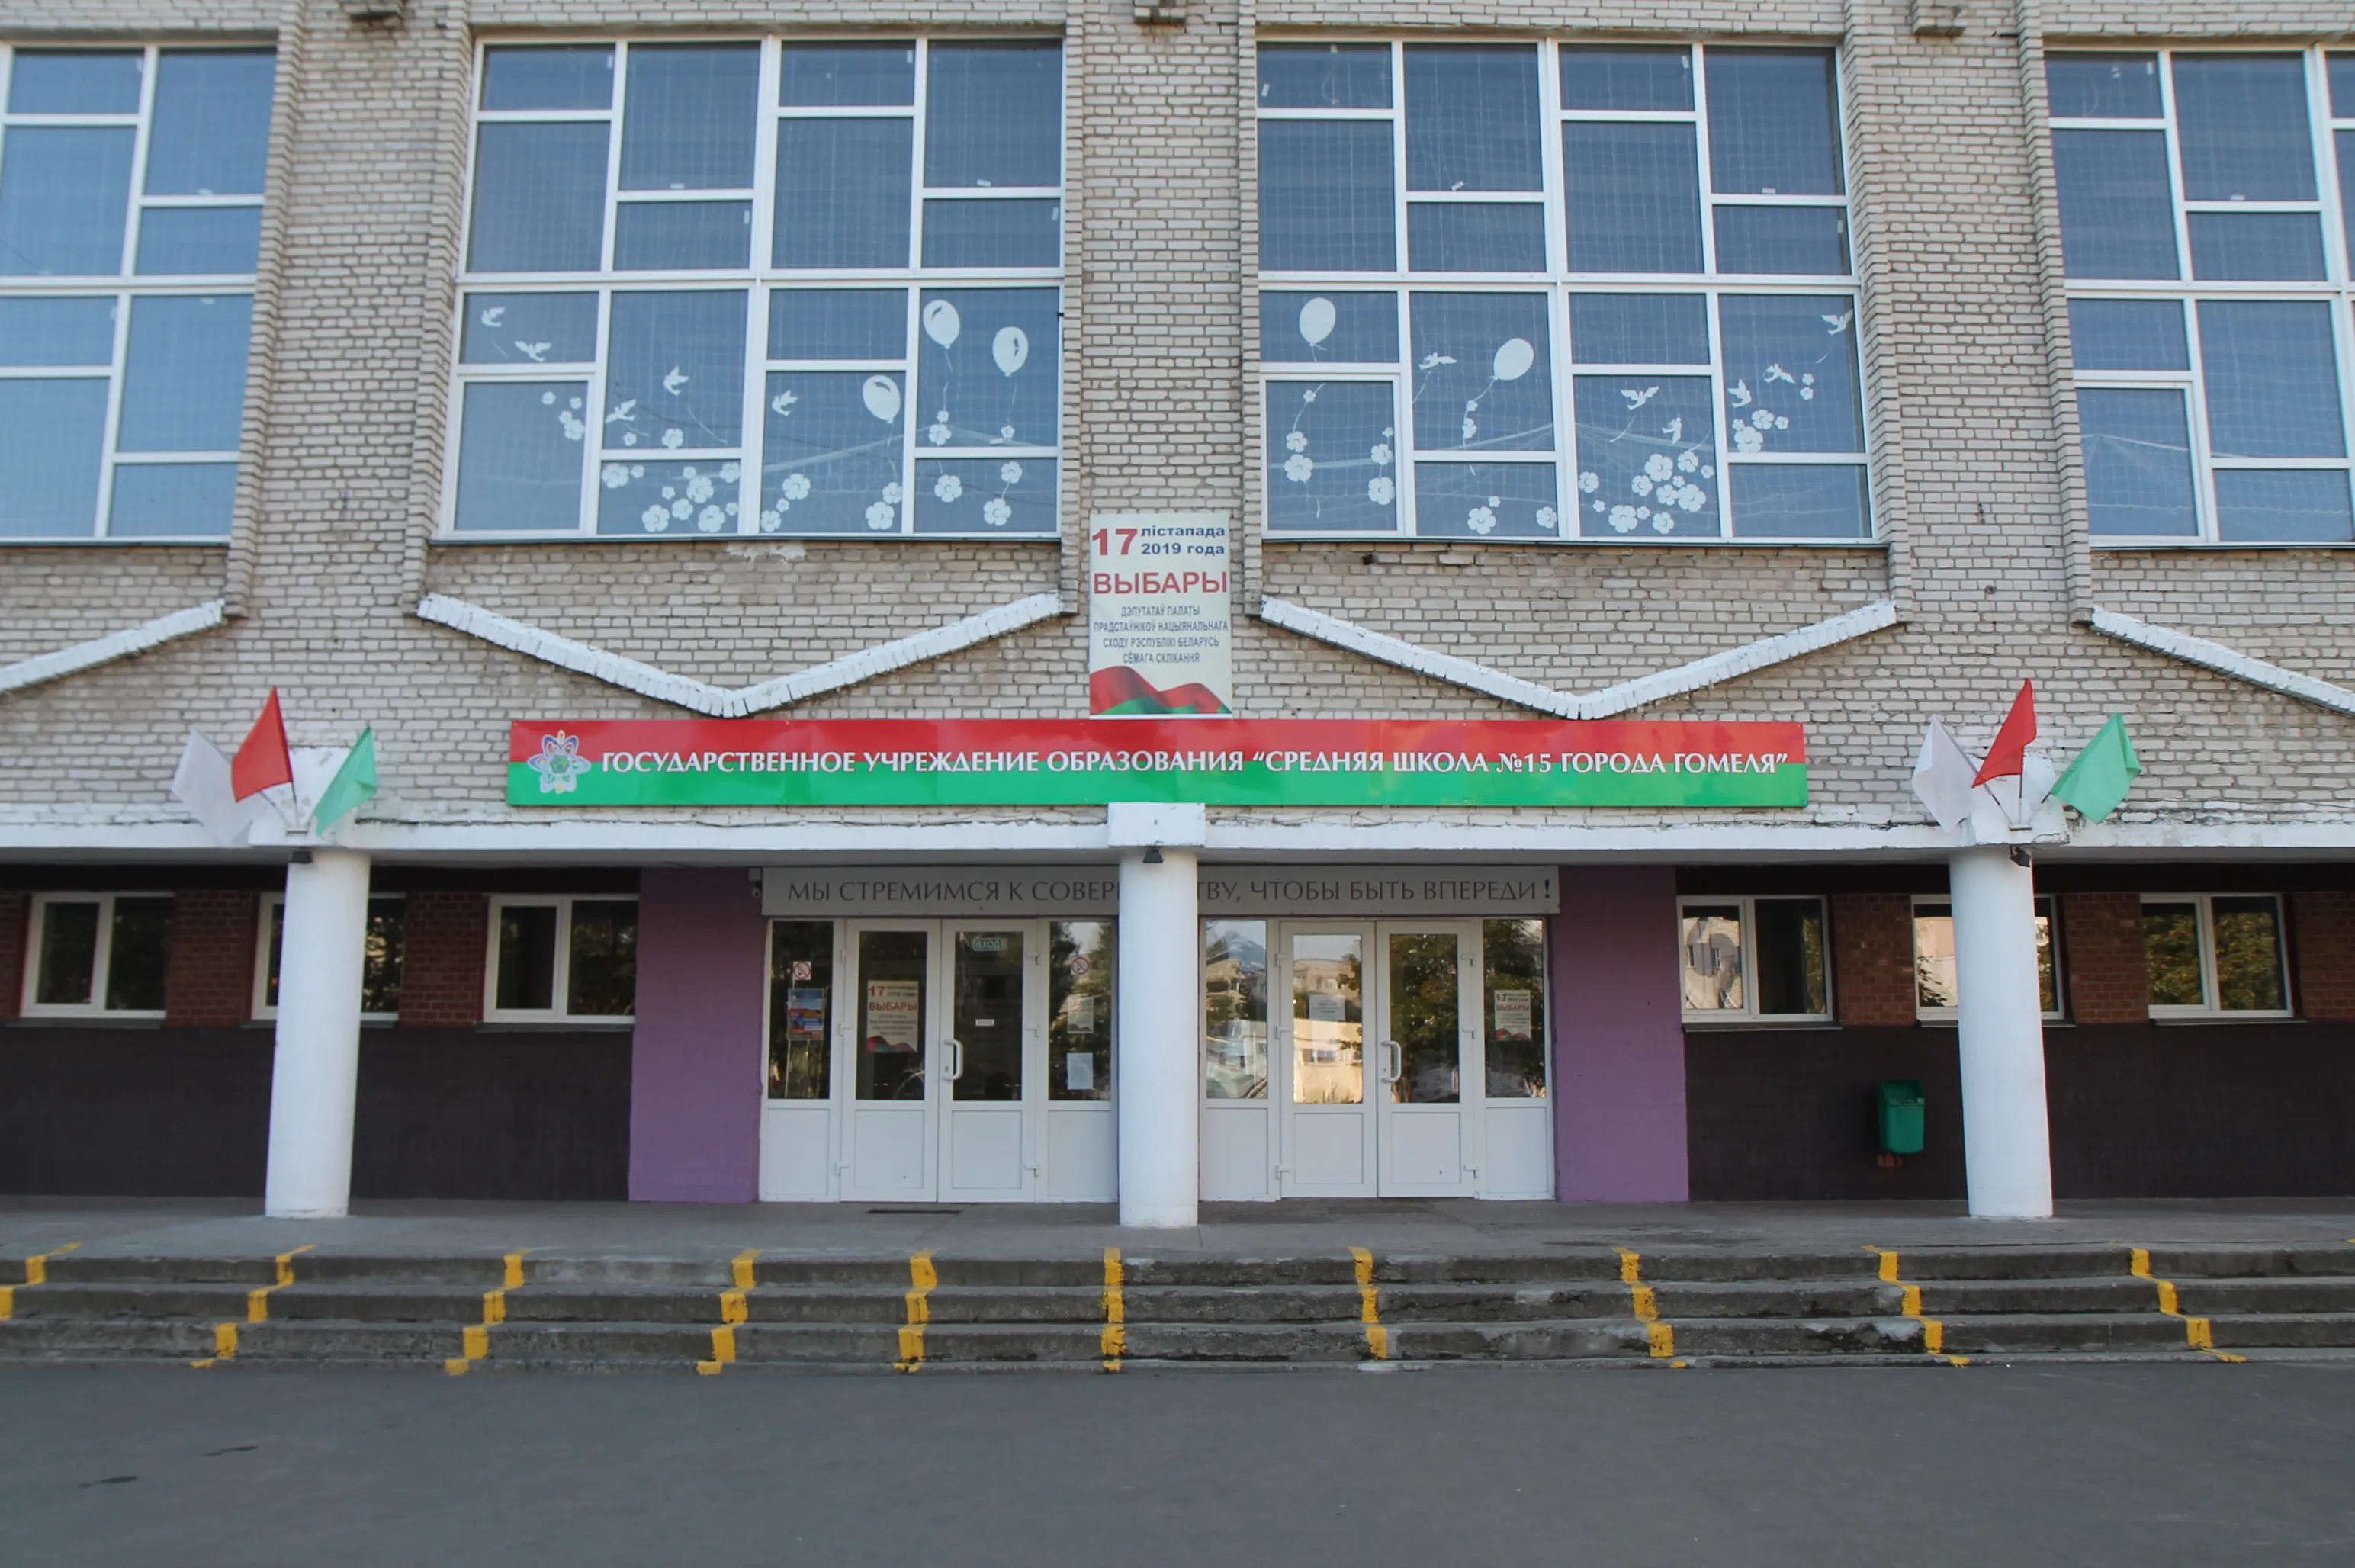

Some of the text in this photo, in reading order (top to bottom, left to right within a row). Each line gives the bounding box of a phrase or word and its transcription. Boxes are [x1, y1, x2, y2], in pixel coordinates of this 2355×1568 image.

[1141, 525, 1226, 538] лістапада
[1092, 528, 1138, 556] 17
[1141, 542, 1226, 557] 2019 года
[1094, 572, 1227, 594] ВЫБАРЫ
[1167, 606, 1200, 616] ПАЛАТЫ
[1158, 620, 1229, 632] НАЦЫЯНАЛЬНАГА
[1103, 638, 1129, 649] СХОДУ
[1178, 636, 1219, 647] БЕЛАРУСЬ
[602, 751, 856, 773] ГОСУДАРСТВЕННОЕ
[863, 751, 1039, 773] УЧРЕЖДЕНИЕ
[1047, 750, 1245, 773] ОБРАЗОВАНИЯ
[1393, 751, 1489, 773] ШКОЛА
[1496, 752, 1552, 773] №15
[1561, 752, 1666, 773] ГОРОДА
[788, 882, 829, 901] МЫ
[840, 881, 1000, 901] СТРЕМИМСЯ
[1010, 882, 1023, 901] К
[1251, 881, 1339, 901] ЧТОБЫ
[1350, 881, 1414, 900] БЫТЬ
[869, 985, 885, 996] 17
[869, 1001, 917, 1011] ВЫБАРЫ
